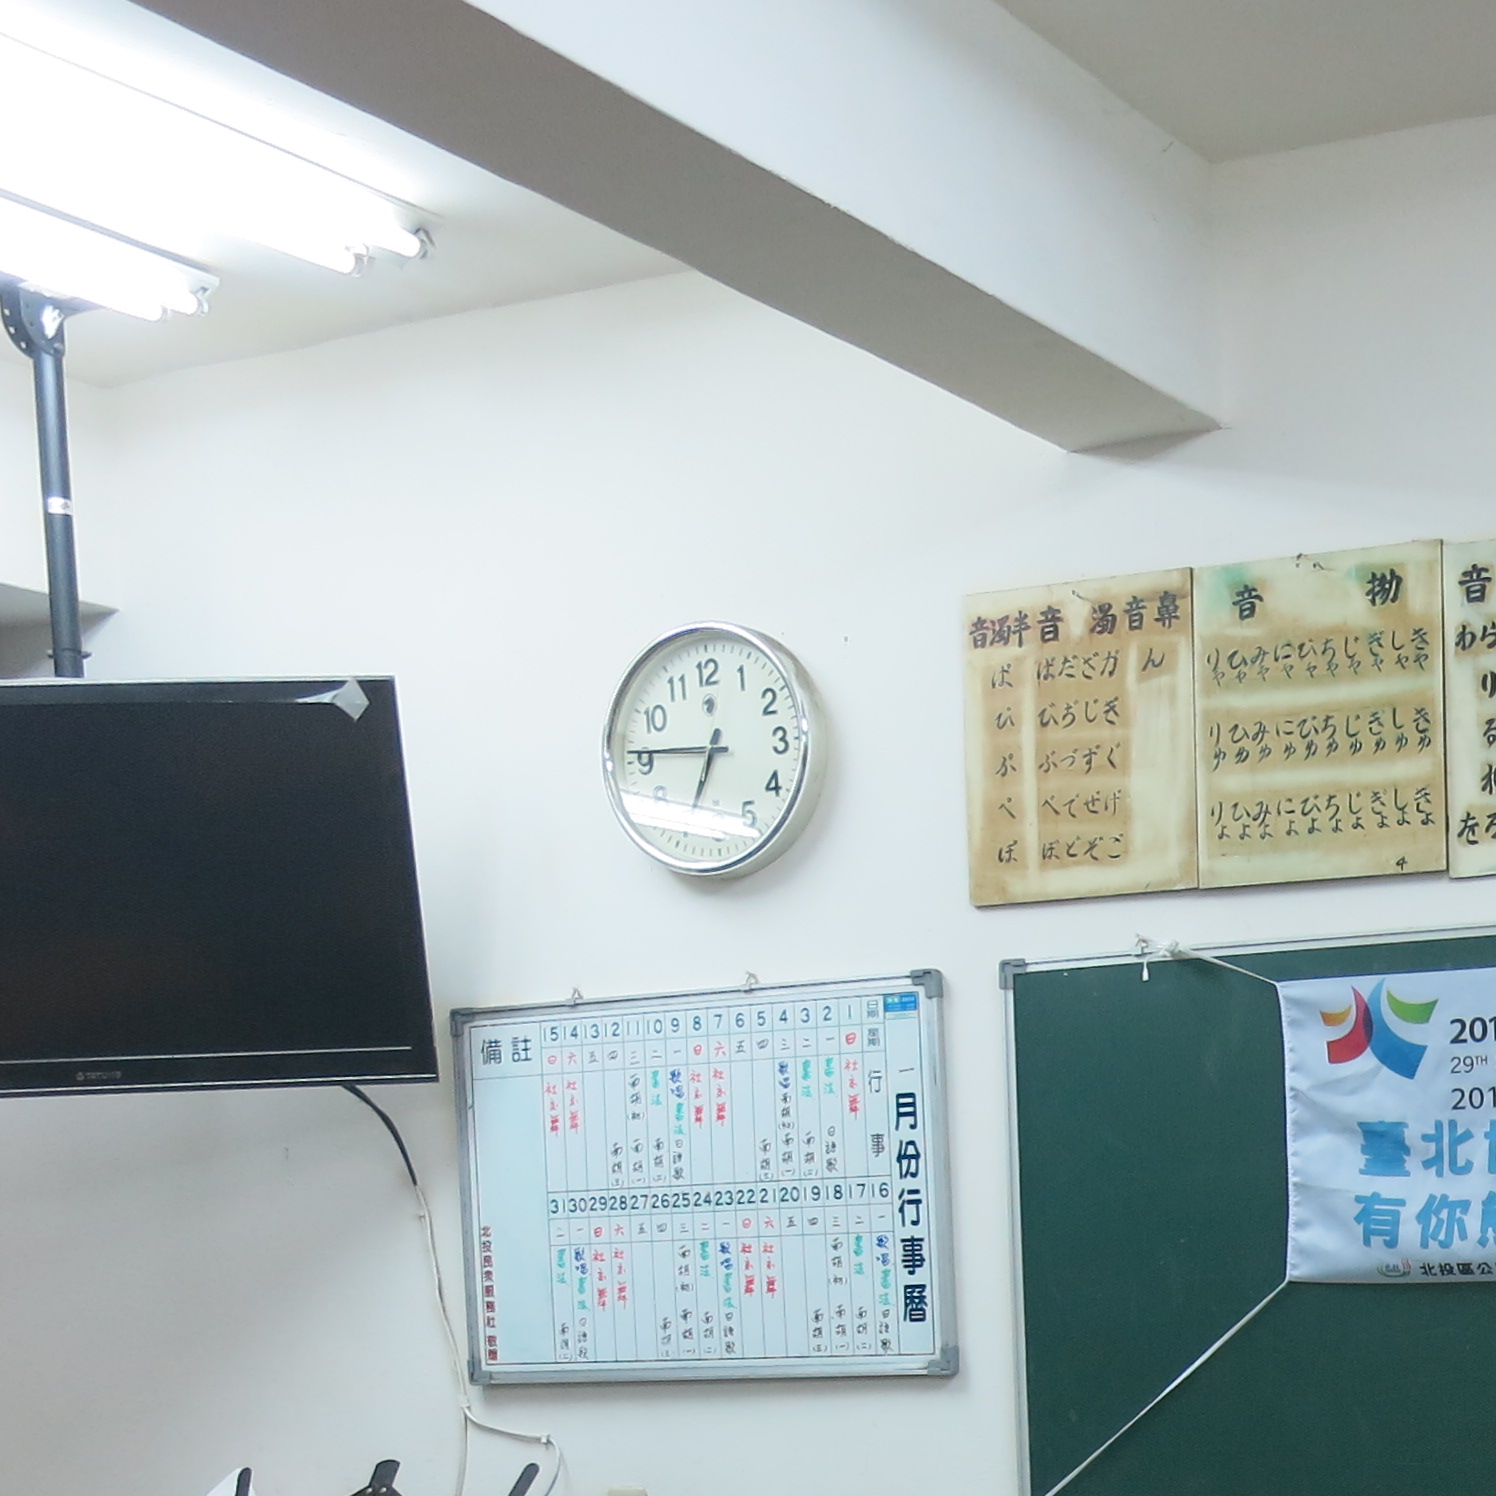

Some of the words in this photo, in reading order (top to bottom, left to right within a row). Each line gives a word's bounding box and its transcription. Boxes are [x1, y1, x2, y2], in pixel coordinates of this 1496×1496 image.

[696, 658, 719, 687] 12
[737, 665, 745, 691] 1
[667, 674, 687, 702] 11
[761, 688, 777, 716] 2
[644, 705, 667, 734] 10
[772, 726, 789, 755] 3
[637, 748, 654, 775] 9
[765, 770, 782, 797] 4
[741, 800, 757, 827] 5
[543, 1026, 559, 1042] 15
[563, 1024, 578, 1041] 14
[584, 1023, 600, 1039] 13
[604, 1022, 620, 1038] 12
[626, 1020, 640, 1036] 11
[646, 1019, 663, 1035] 10
[670, 1017, 680, 1033] 9
[692, 1015, 702, 1031] 8
[713, 1014, 723, 1029] 7
[735, 1013, 745, 1028] 6
[757, 1011, 766, 1026] 5
[779, 1009, 788, 1024] 4
[800, 1008, 810, 1023] 3
[823, 1006, 832, 1021] 2
[847, 1004, 852, 1019] 1
[481, 1036, 532, 1065] 備註
[1450, 1054, 1488, 1075] 29TH
[550, 1199, 566, 1214] 31
[569, 1198, 587, 1213] 30
[589, 1197, 608, 1212] 29
[609, 1195, 628, 1211] 28
[630, 1195, 649, 1210] 27
[651, 1193, 670, 1209] 26
[672, 1192, 691, 1208] 25
[693, 1192, 712, 1207] 24
[715, 1190, 734, 1206] 23
[736, 1189, 756, 1204] 22
[760, 1188, 776, 1203] 21
[780, 1186, 800, 1202] 20
[804, 1185, 821, 1201] 19
[826, 1184, 843, 1200] 18
[849, 1184, 866, 1199] 17
[872, 1182, 889, 1198] 16
